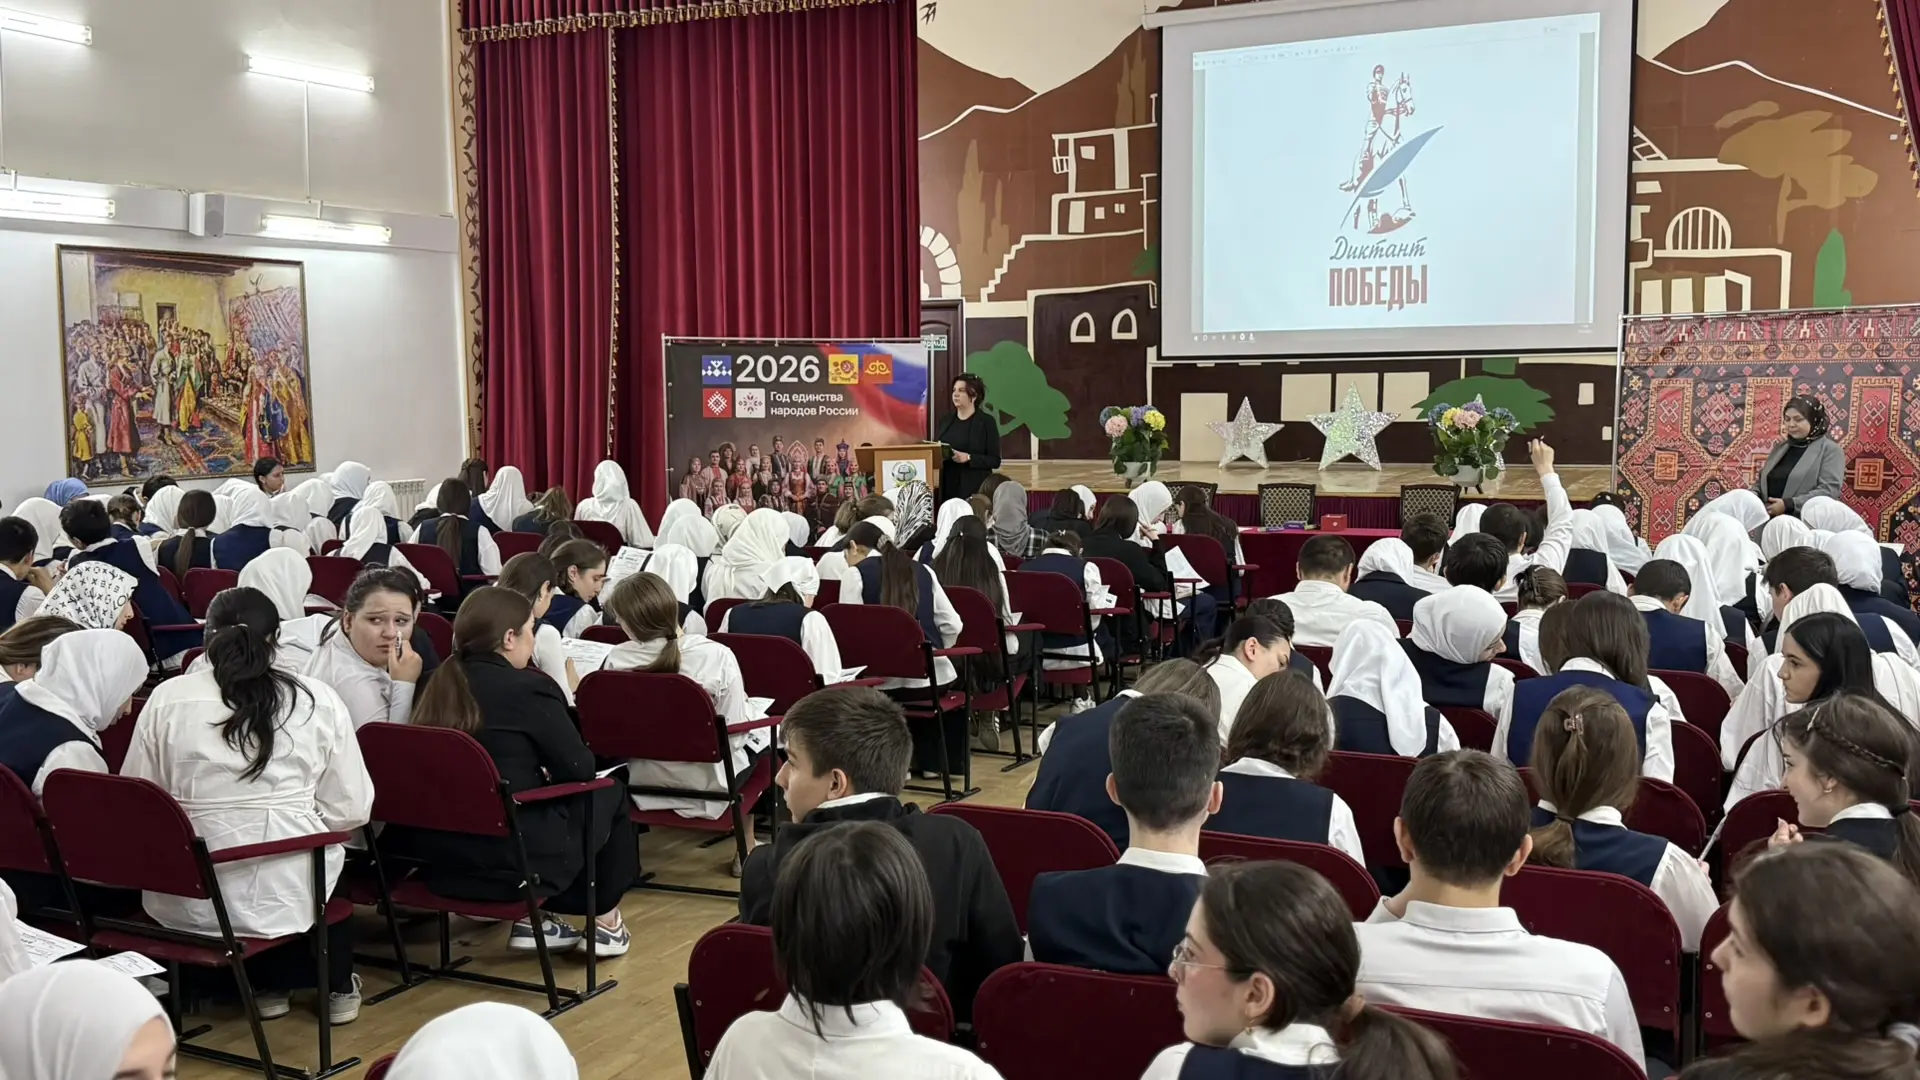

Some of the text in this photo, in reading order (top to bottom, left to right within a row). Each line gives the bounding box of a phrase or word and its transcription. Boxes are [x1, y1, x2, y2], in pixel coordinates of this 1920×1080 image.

[1329, 235, 1428, 260] Диктант
[1329, 264, 1428, 312] ПОБЕДЫ
[736, 354, 820, 383] 2026
[770, 391, 843, 402] Год единства
[770, 405, 859, 417] народов России
